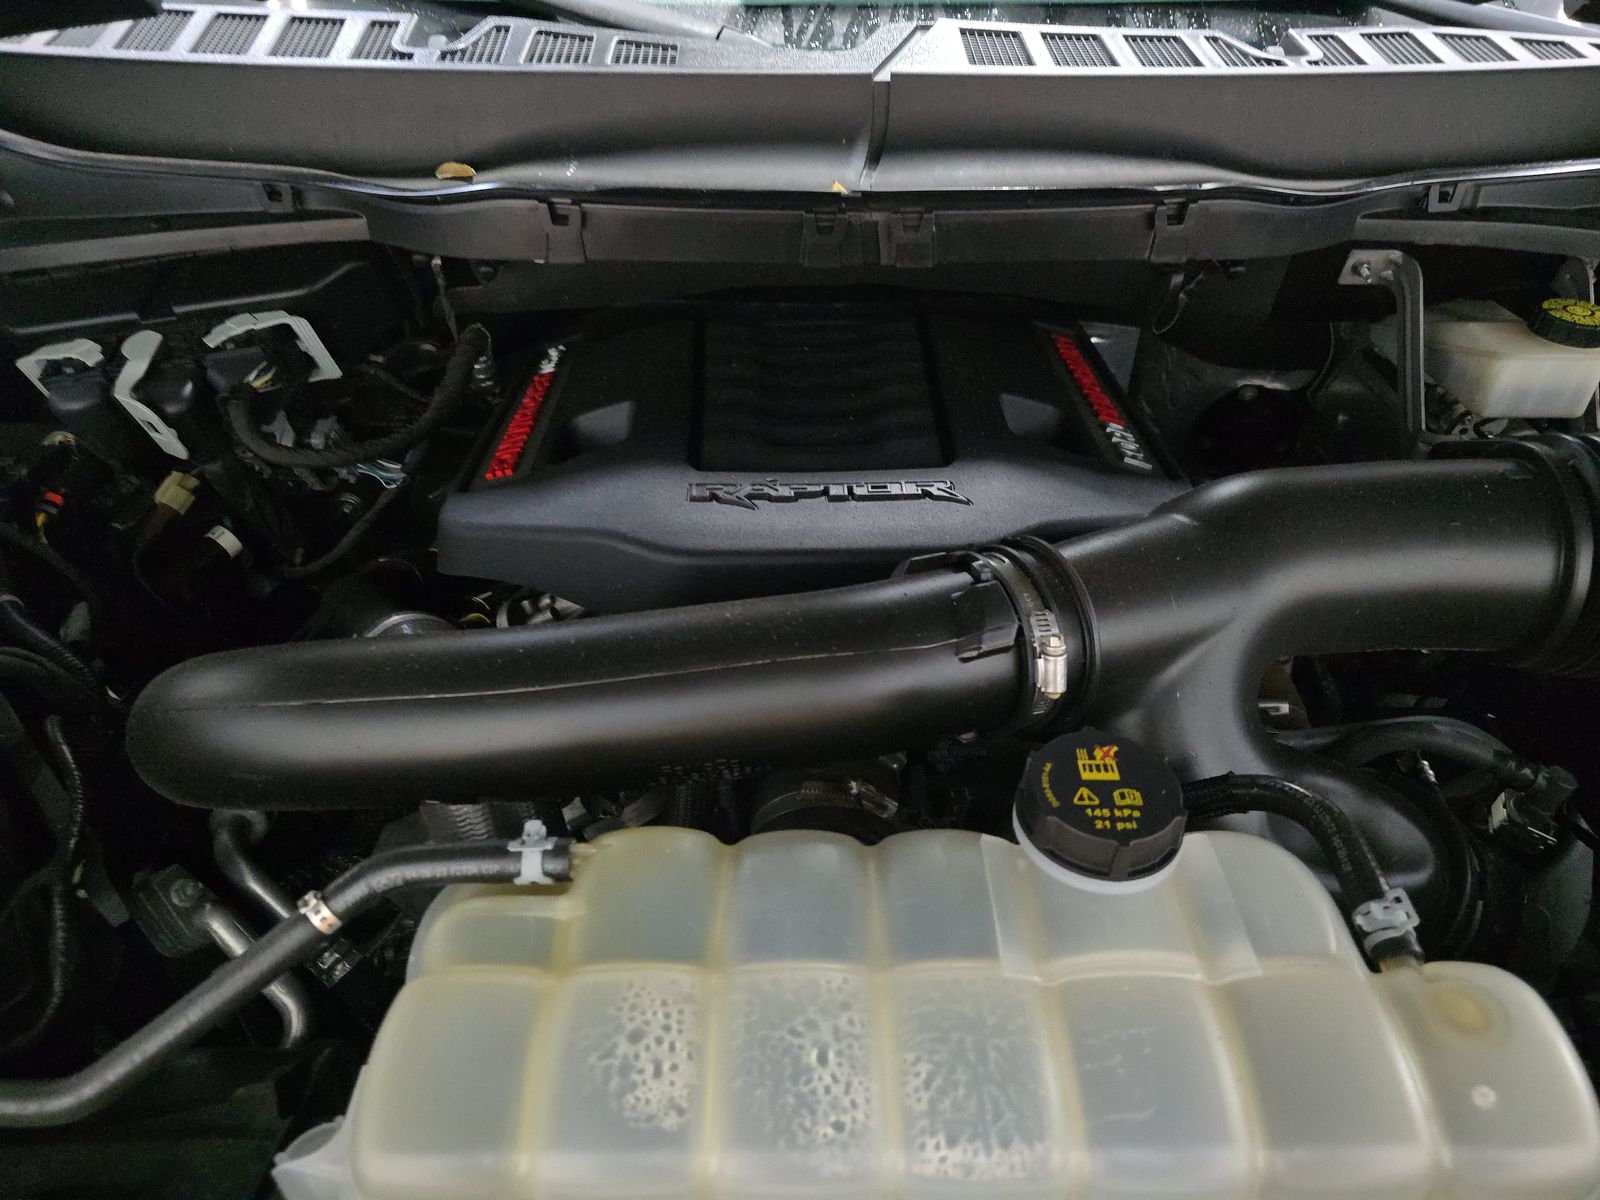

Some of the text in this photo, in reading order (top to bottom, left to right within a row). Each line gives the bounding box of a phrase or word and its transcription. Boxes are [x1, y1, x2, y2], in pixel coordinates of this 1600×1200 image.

[687, 477, 974, 510] RAPTOR
[1085, 807, 1141, 818] 145 kPa
[1094, 819, 1138, 832] 21 psi
